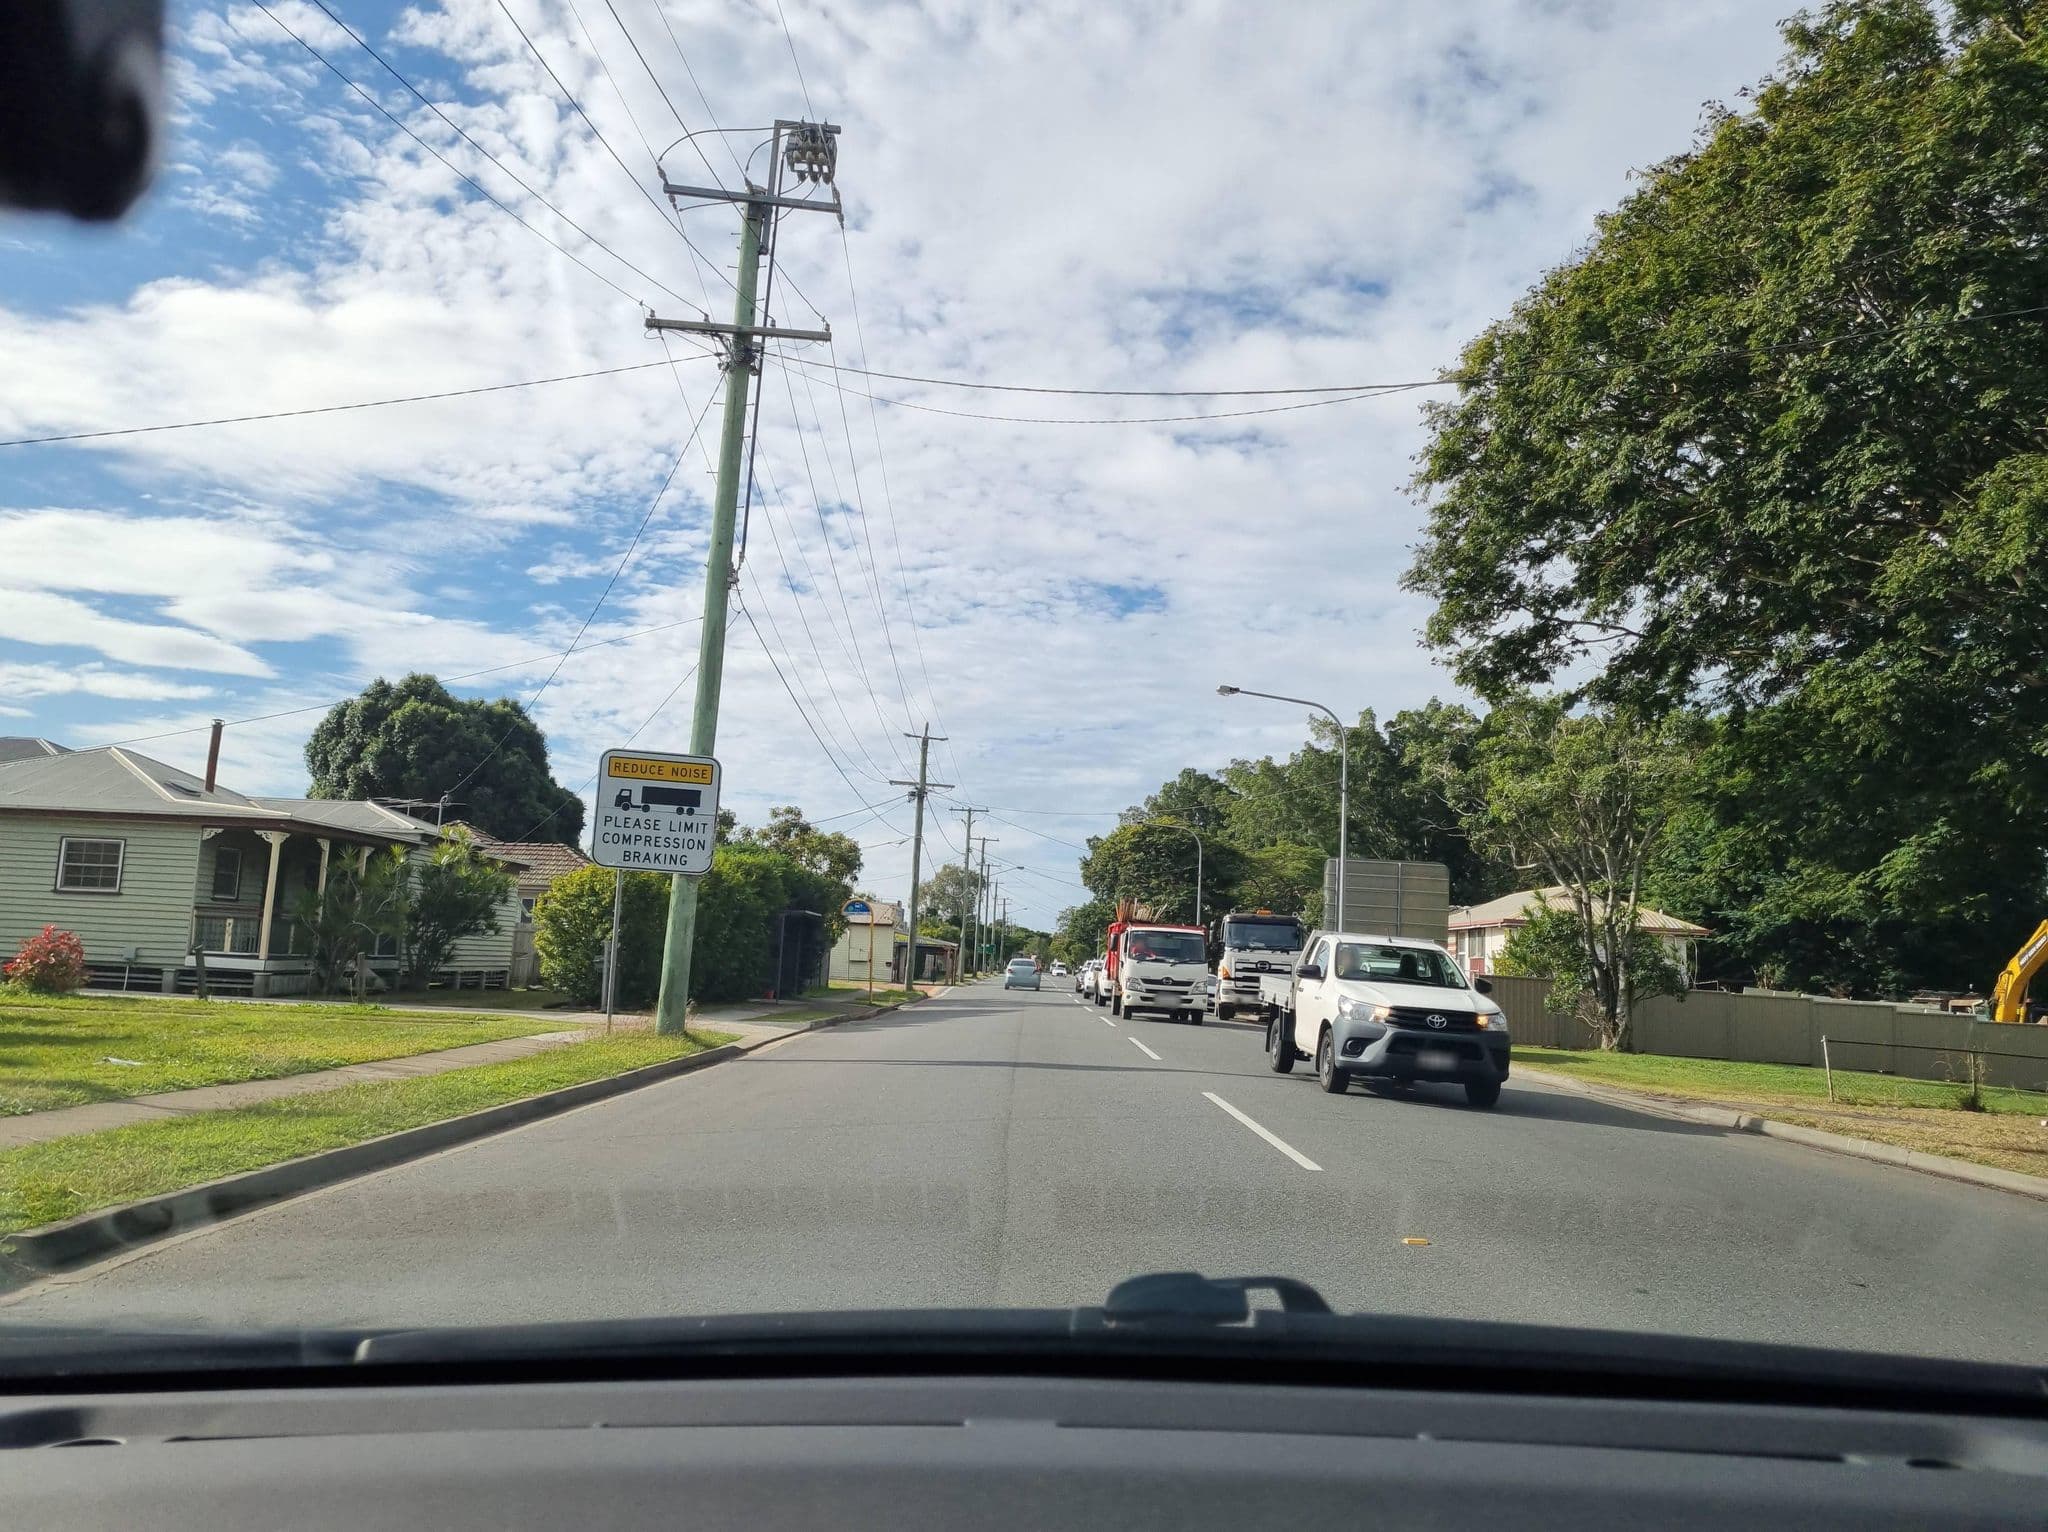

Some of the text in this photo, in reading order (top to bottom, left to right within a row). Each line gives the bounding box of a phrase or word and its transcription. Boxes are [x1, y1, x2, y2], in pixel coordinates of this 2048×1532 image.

[614, 762, 708, 779] REDUCE NOISE
[603, 815, 708, 834] PLEASE LIMIT
[602, 832, 706, 851] COMPRESSION
[623, 850, 688, 866] BRAKING
